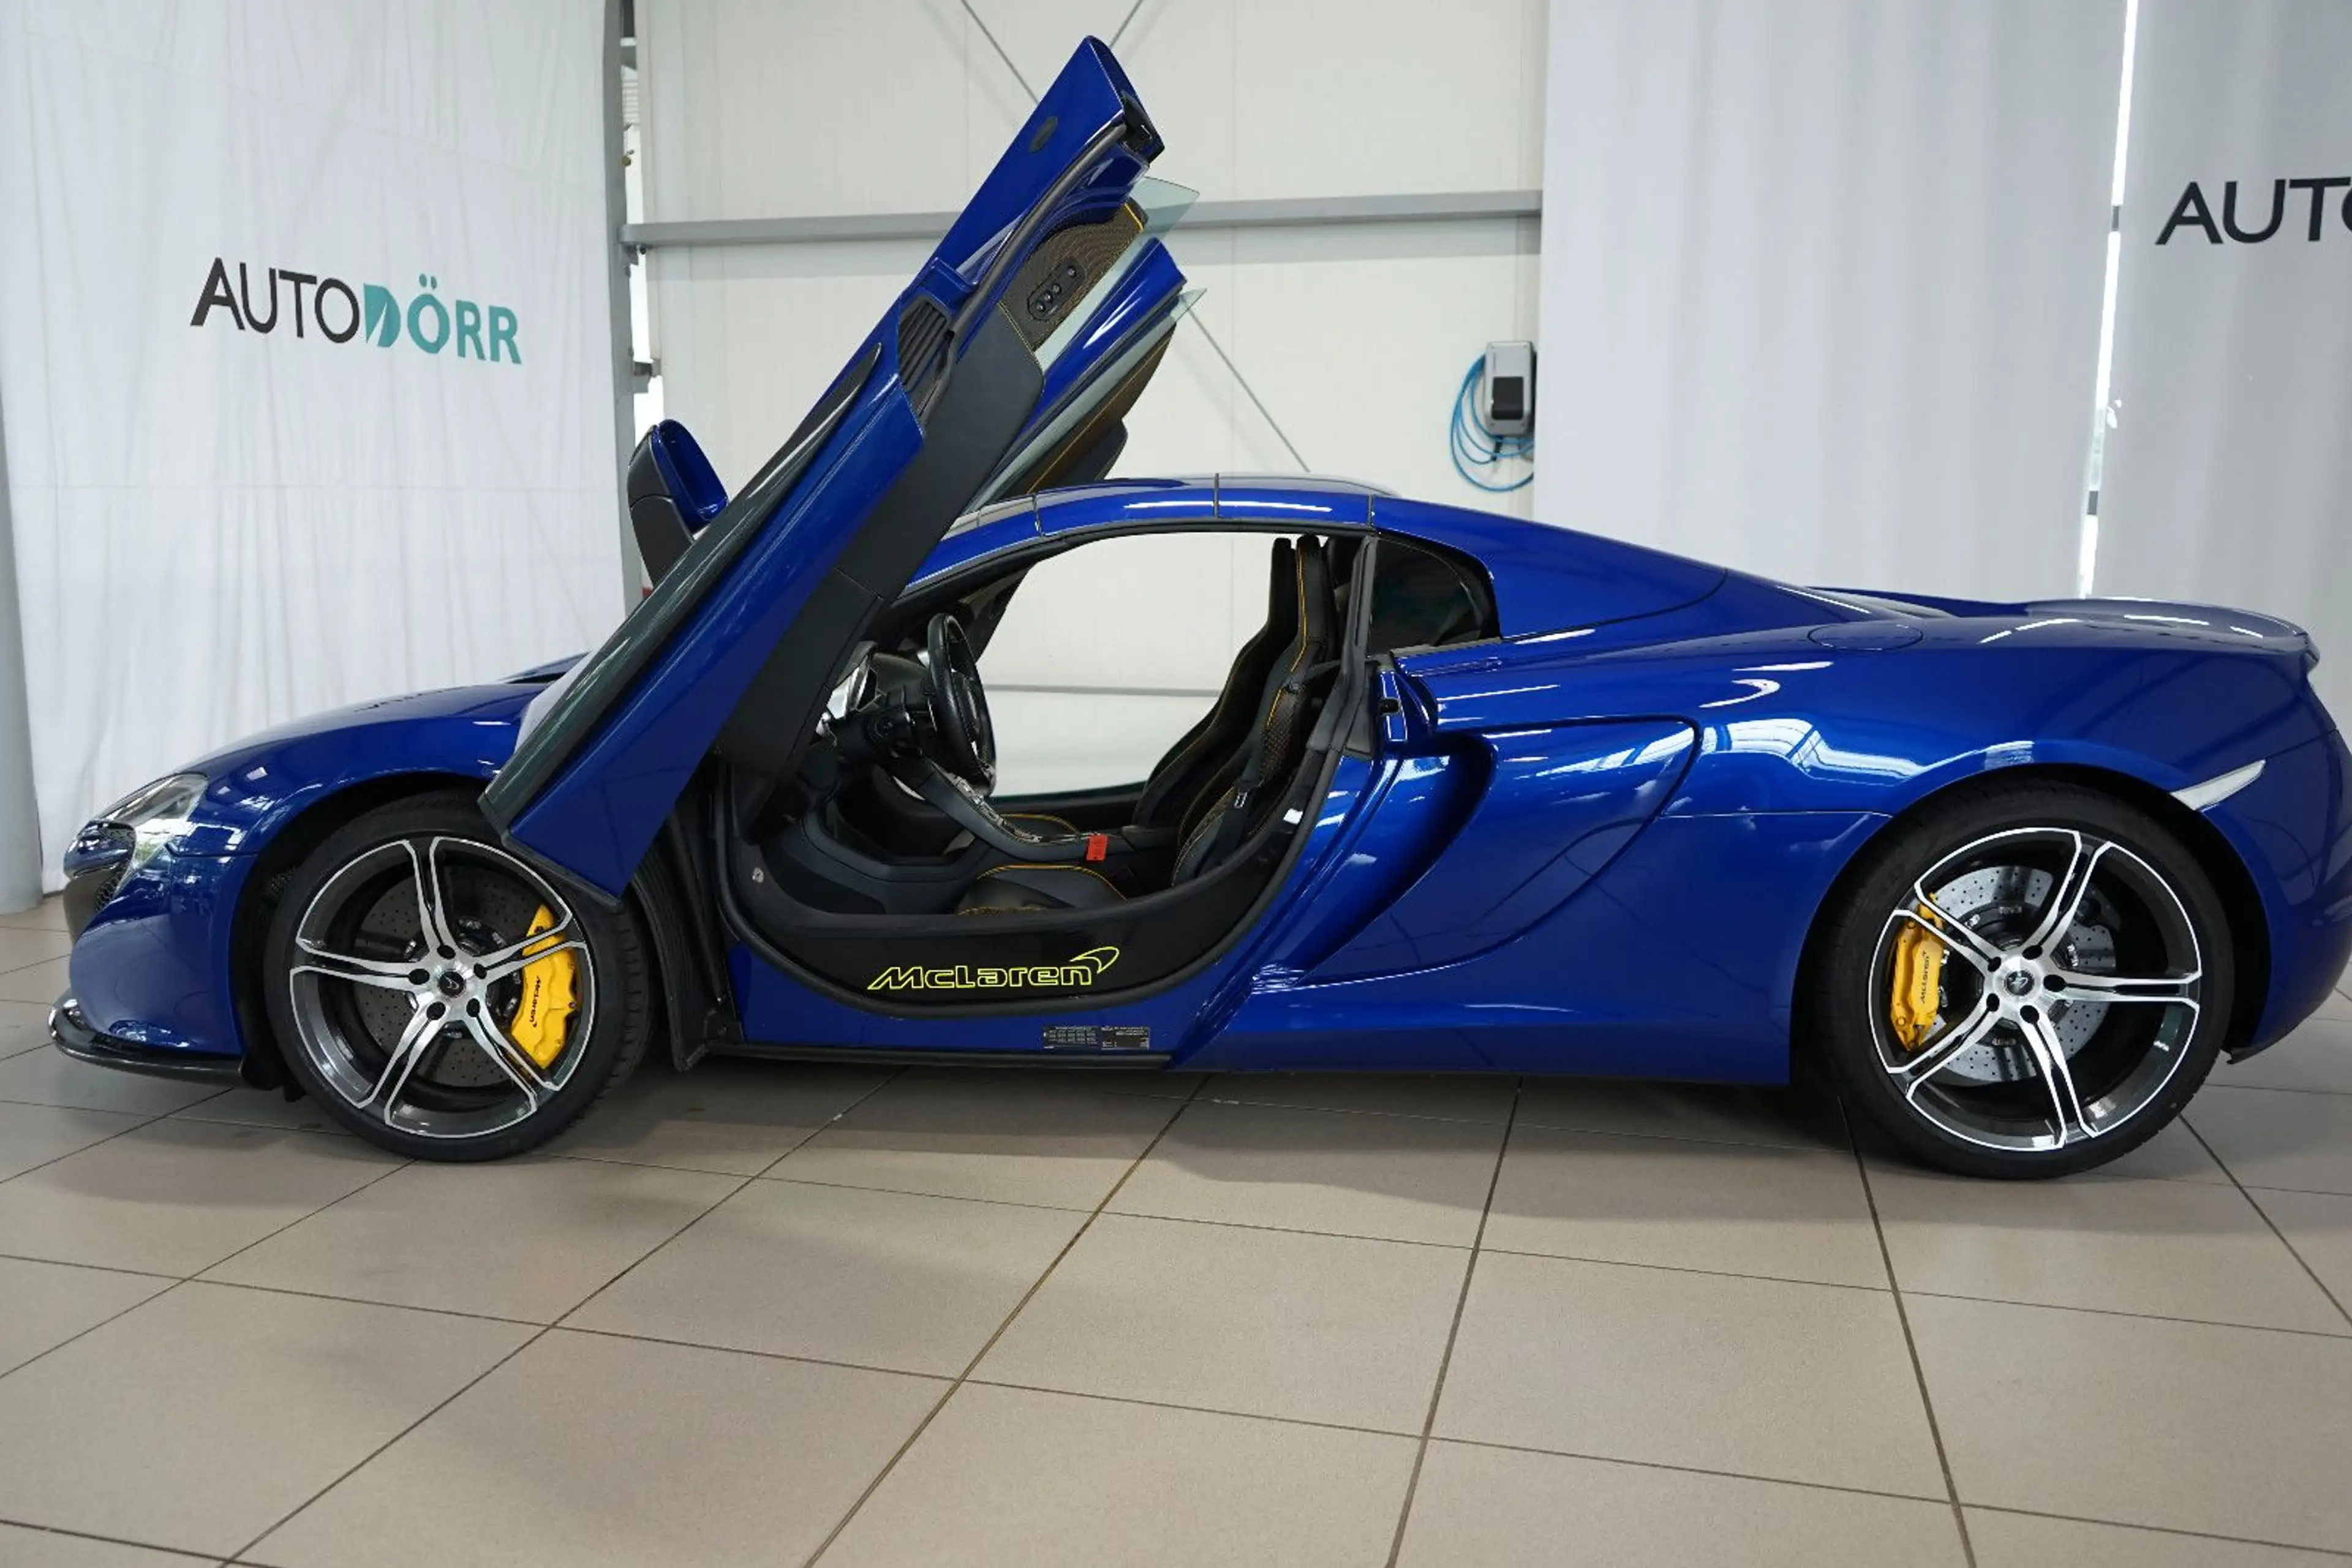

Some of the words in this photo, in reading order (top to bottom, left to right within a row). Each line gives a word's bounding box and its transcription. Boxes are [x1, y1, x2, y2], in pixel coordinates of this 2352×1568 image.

[2154, 176, 2352, 245] AUT
[190, 257, 521, 364] AUTODÖRR
[867, 965, 1092, 990] McLaren
